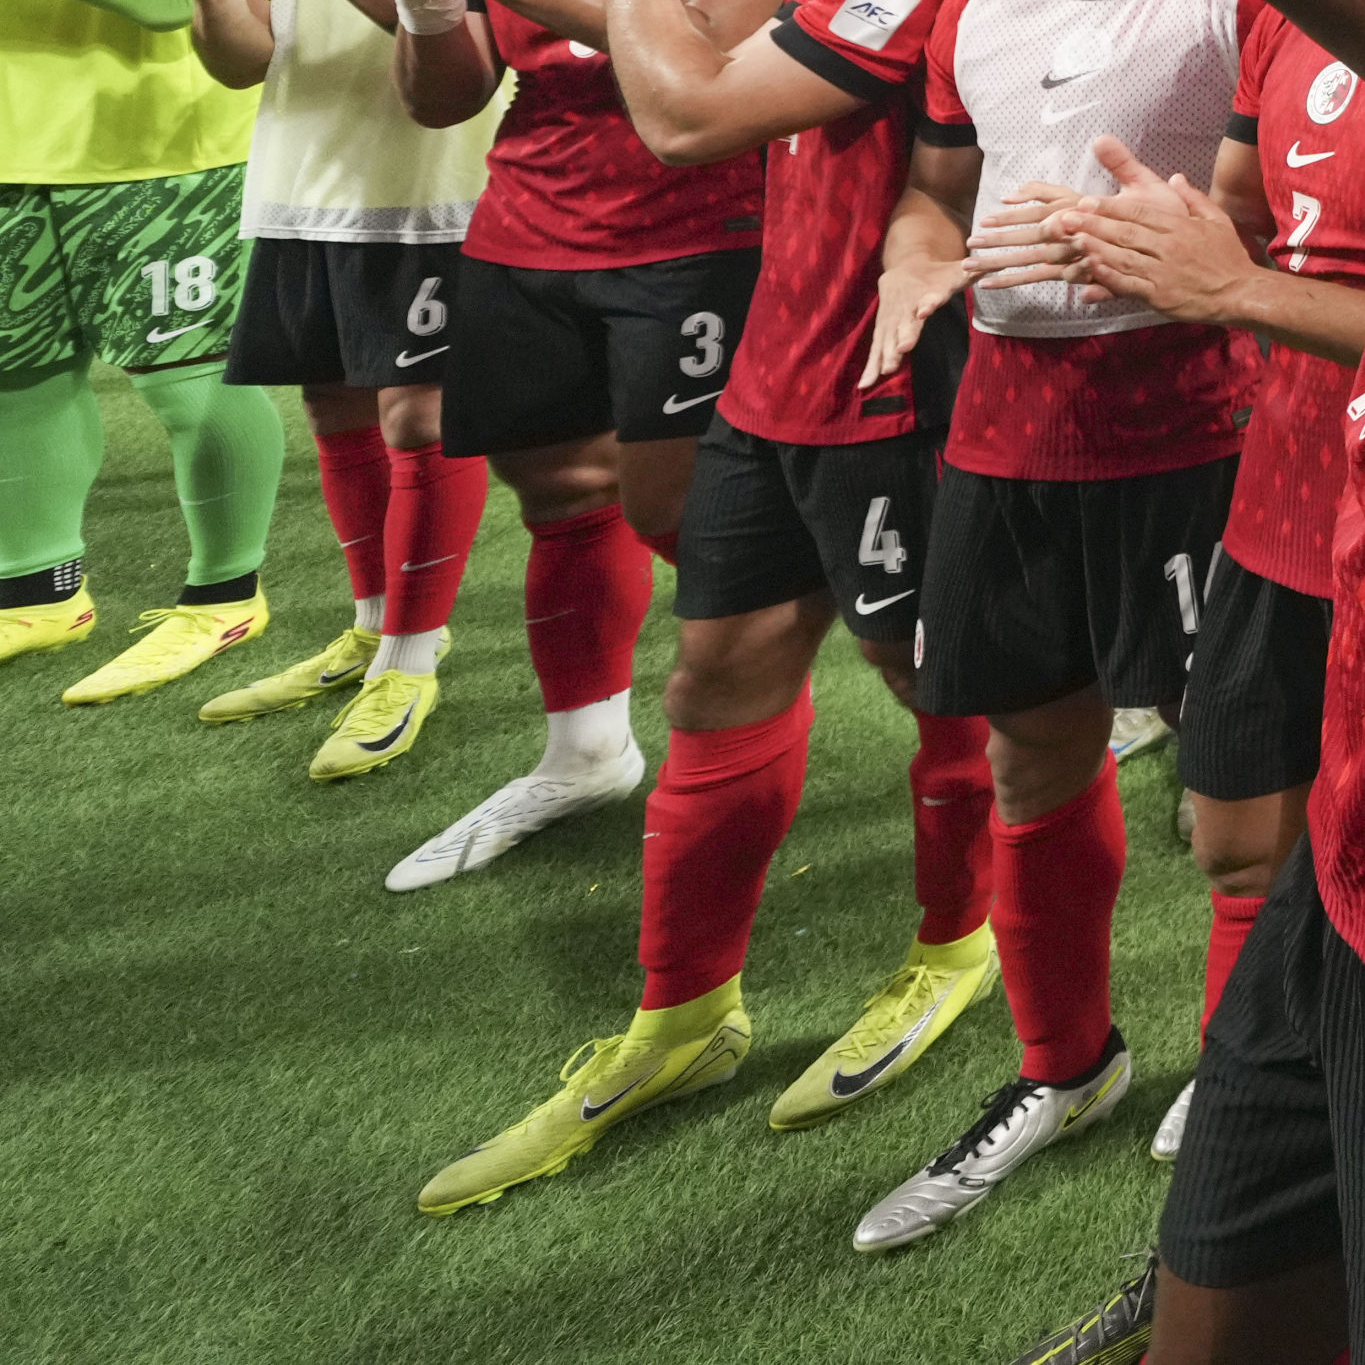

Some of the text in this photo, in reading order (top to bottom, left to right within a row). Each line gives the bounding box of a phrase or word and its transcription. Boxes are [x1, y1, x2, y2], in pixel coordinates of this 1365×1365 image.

[850, 2, 897, 25] AFC
[1287, 190, 1321, 272] 7
[141, 255, 218, 317] 18
[406, 276, 448, 336] 6
[679, 311, 725, 378] 3
[858, 496, 907, 574] 4
